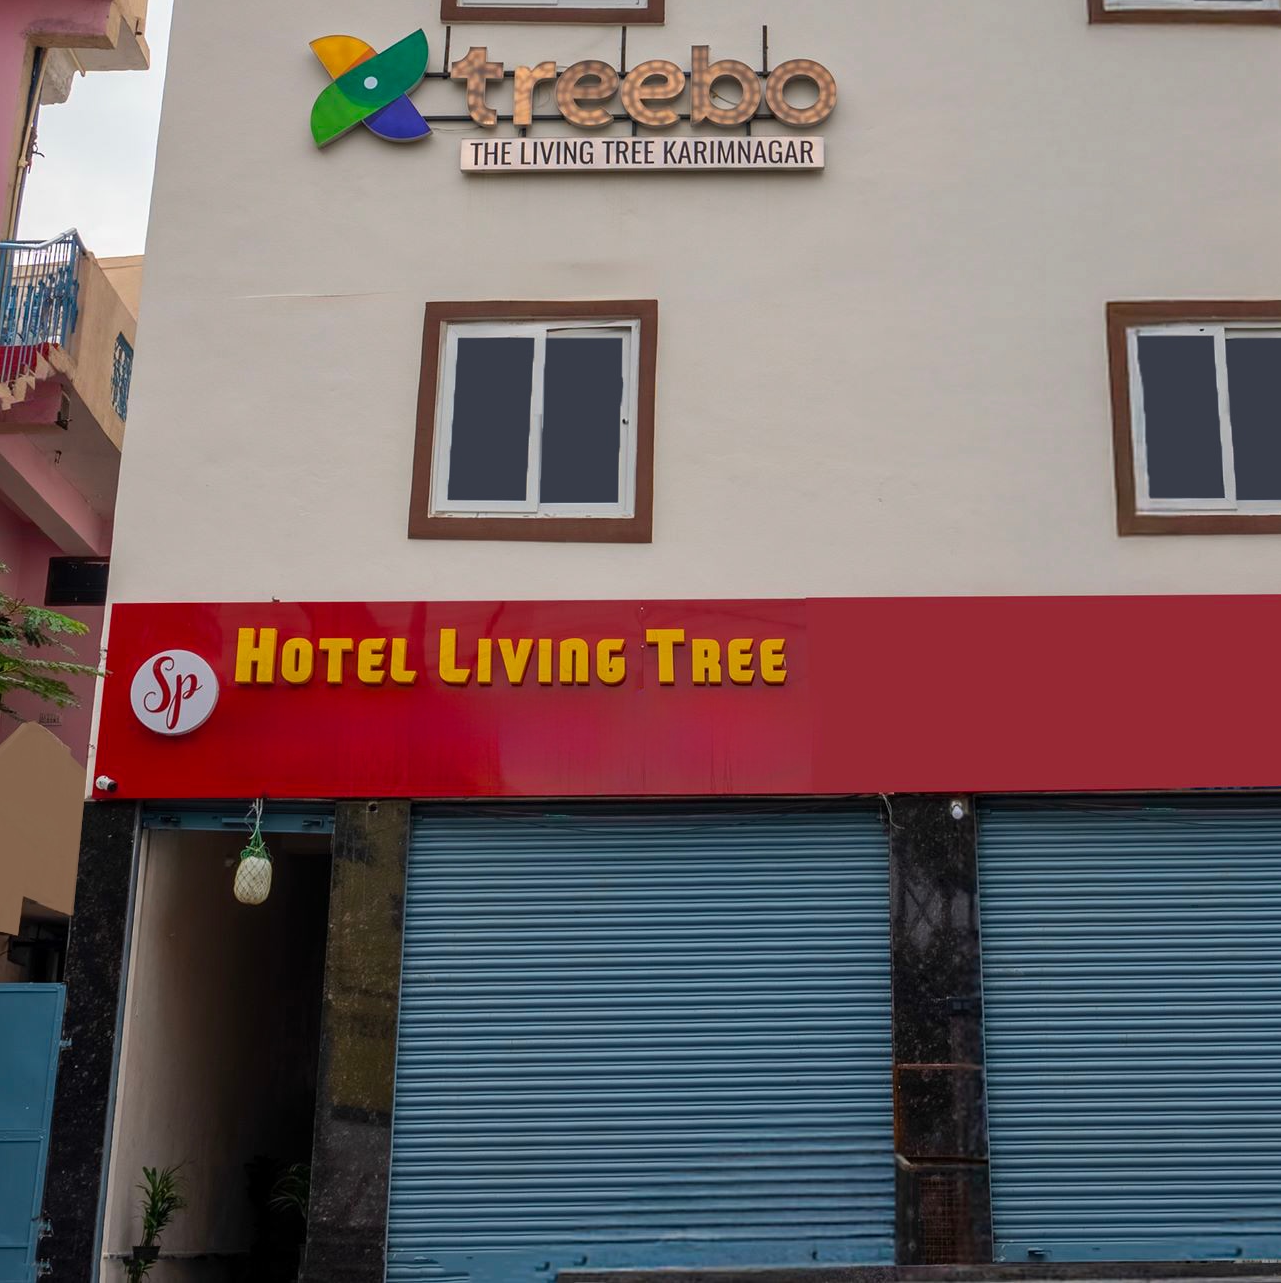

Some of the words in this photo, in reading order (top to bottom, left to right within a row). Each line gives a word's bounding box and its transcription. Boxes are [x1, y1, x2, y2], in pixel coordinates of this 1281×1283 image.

[451, 45, 837, 129] treebo
[470, 142, 512, 165] THE
[519, 142, 594, 165] LIVING
[601, 141, 655, 165] TREE
[663, 140, 814, 165] KARIMNAGAR
